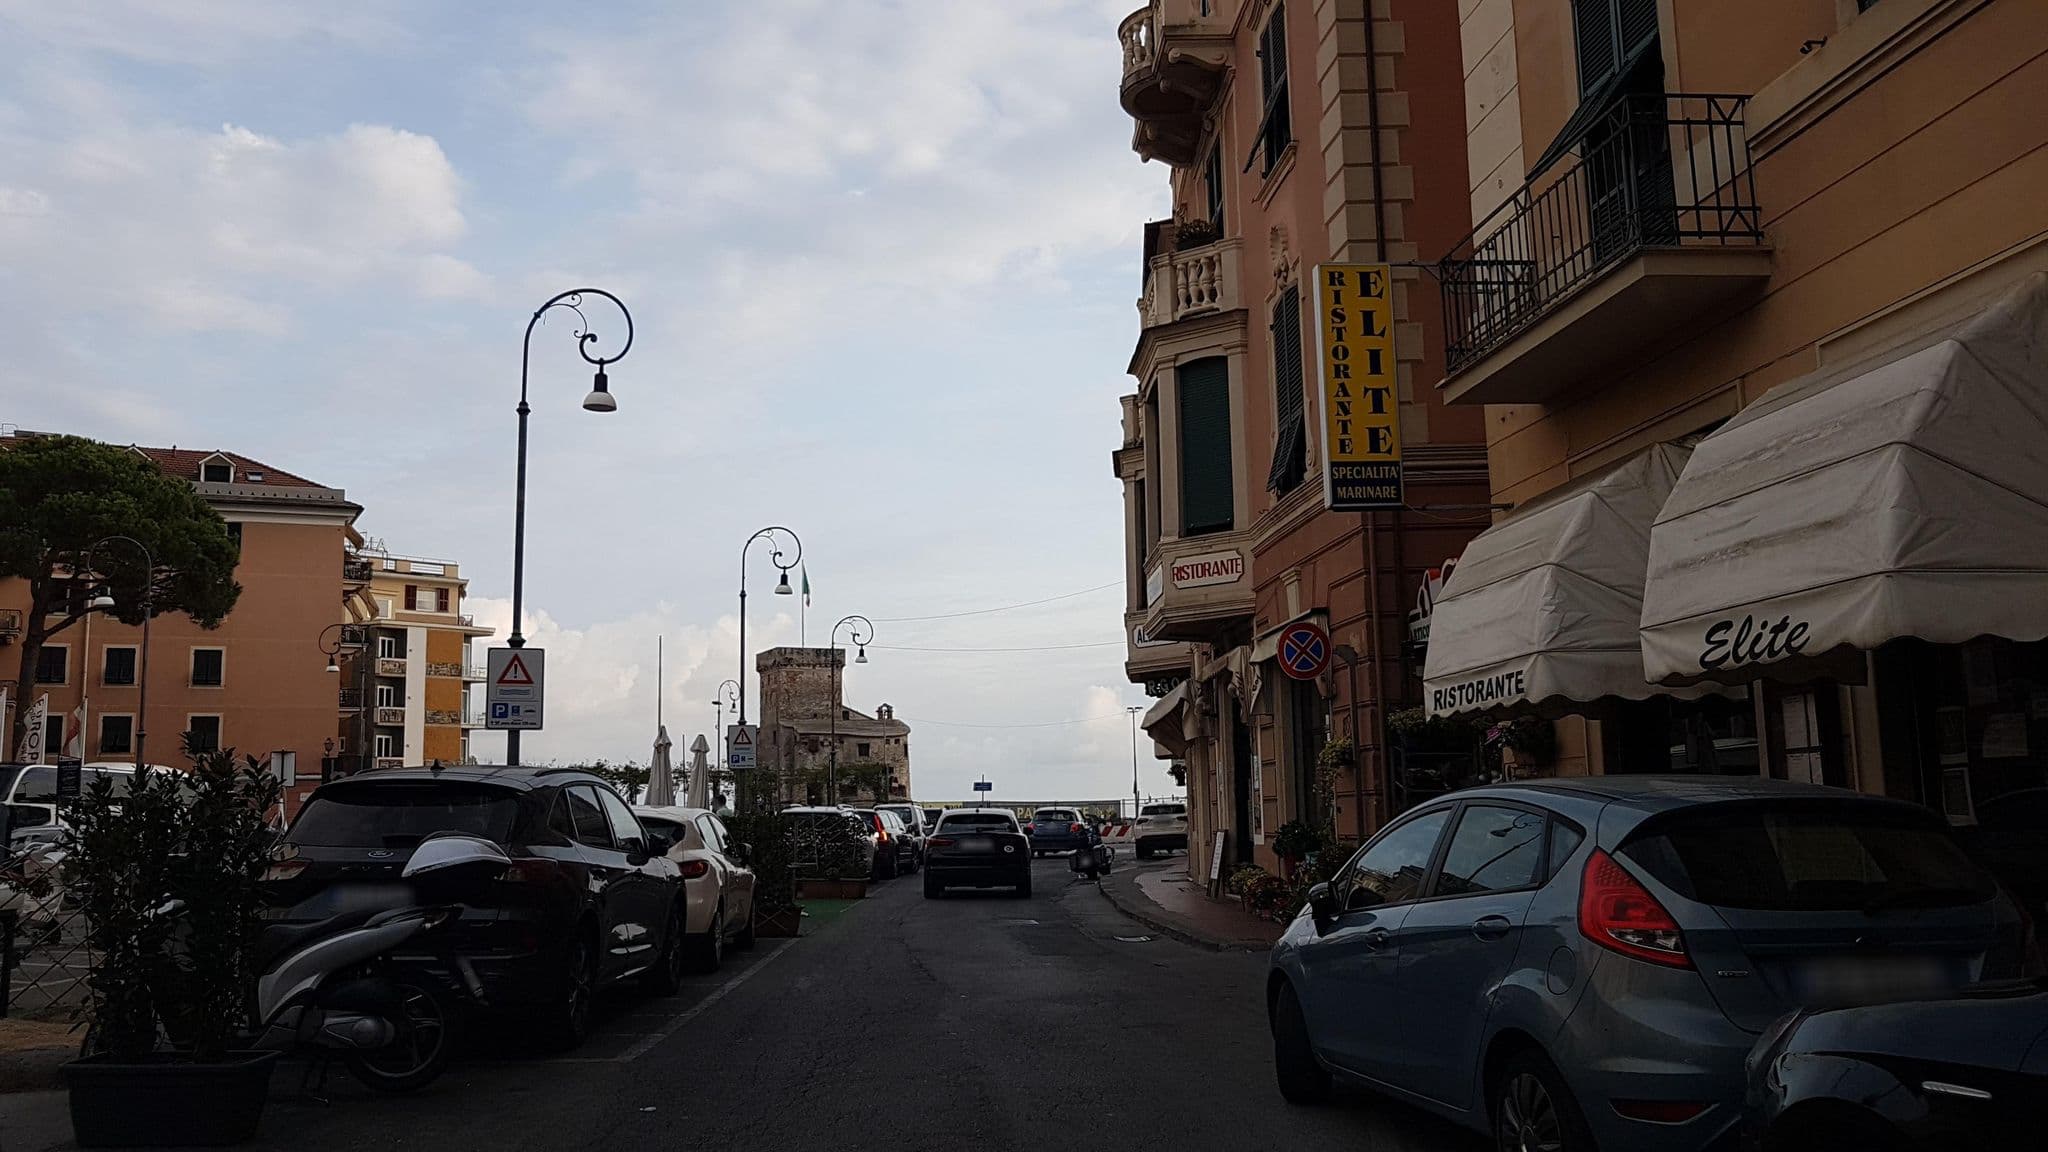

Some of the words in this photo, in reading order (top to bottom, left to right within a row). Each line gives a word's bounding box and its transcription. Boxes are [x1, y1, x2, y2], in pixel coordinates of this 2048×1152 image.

[1327, 270, 1354, 455] RISTORANTE
[1356, 270, 1393, 456] ELITE
[1332, 466, 1400, 479] SPECIALITA'
[1337, 485, 1398, 499] MARINARE
[1172, 558, 1241, 581] RISTORANTE
[1699, 614, 1812, 671] Elite
[1433, 670, 1525, 712] RISTORANTE
